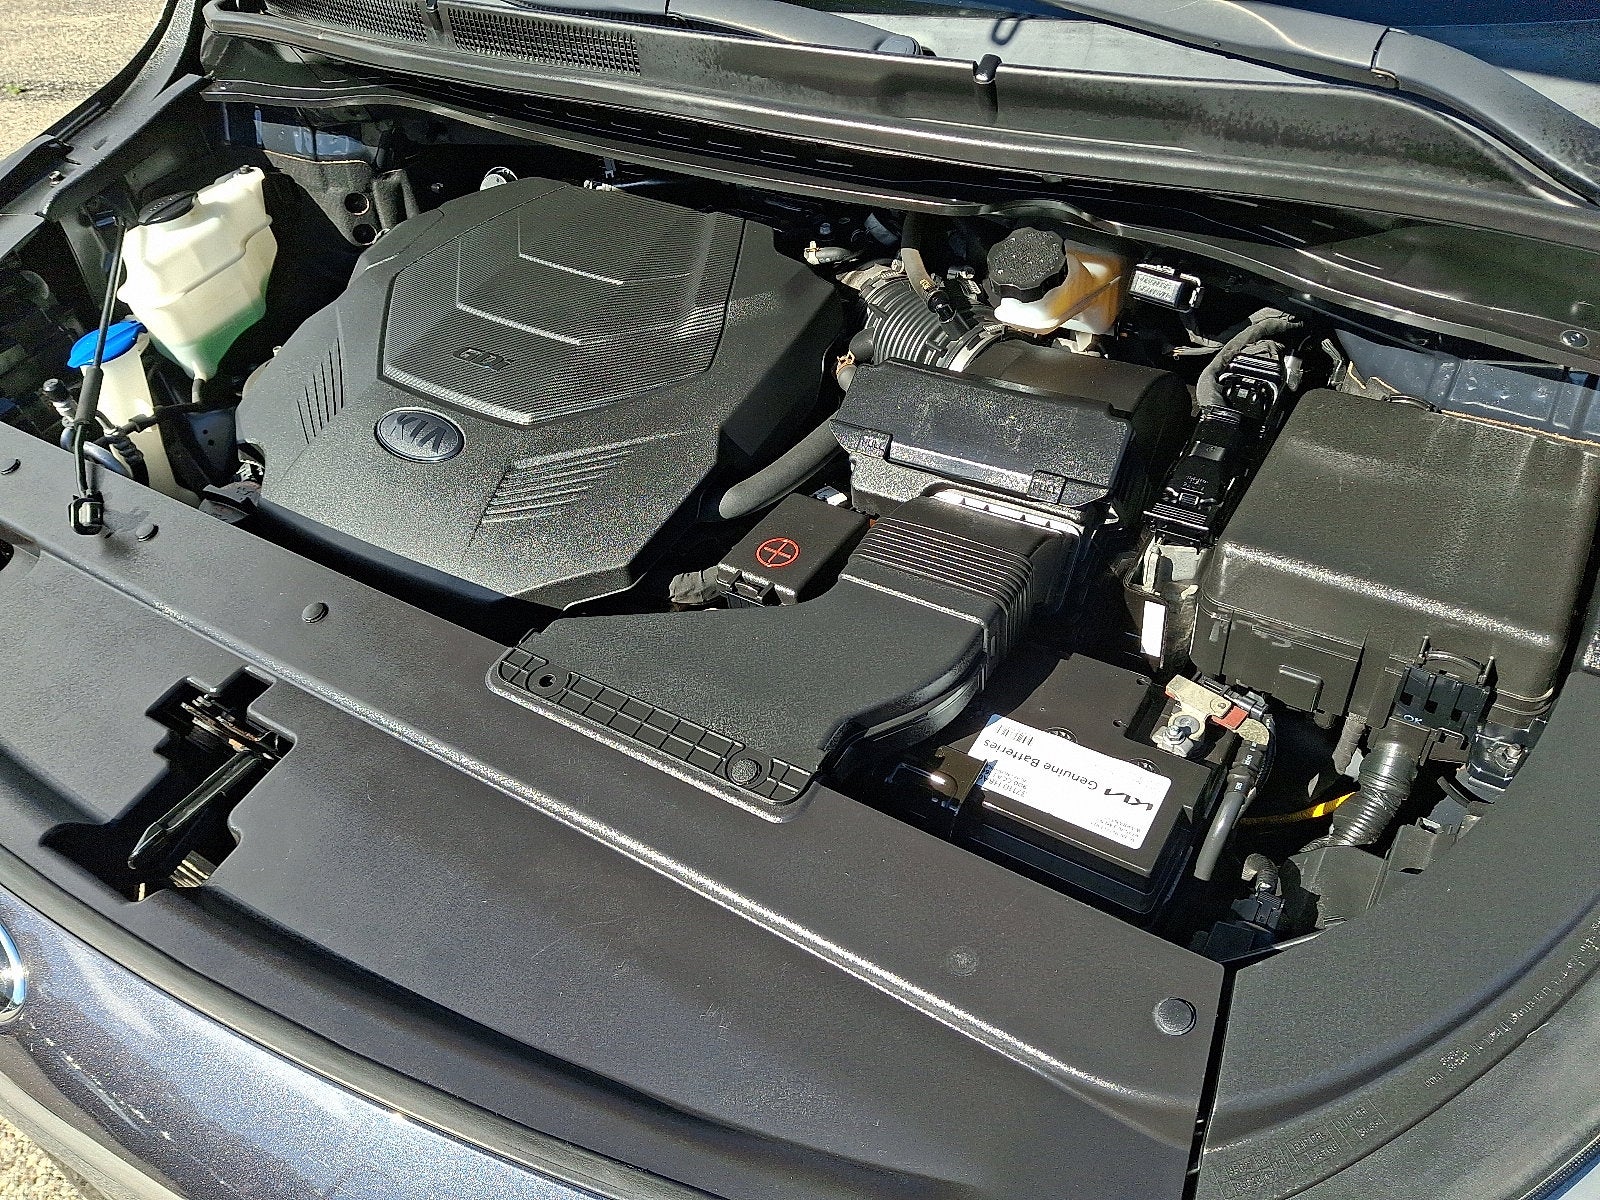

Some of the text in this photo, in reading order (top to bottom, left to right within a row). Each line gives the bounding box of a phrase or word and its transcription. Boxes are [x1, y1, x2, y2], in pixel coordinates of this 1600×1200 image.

[390, 413, 448, 455] KIA
[1403, 714, 1423, 726] OK
[983, 739, 1041, 768] Batteries
[1043, 762, 1098, 791] Genuine
